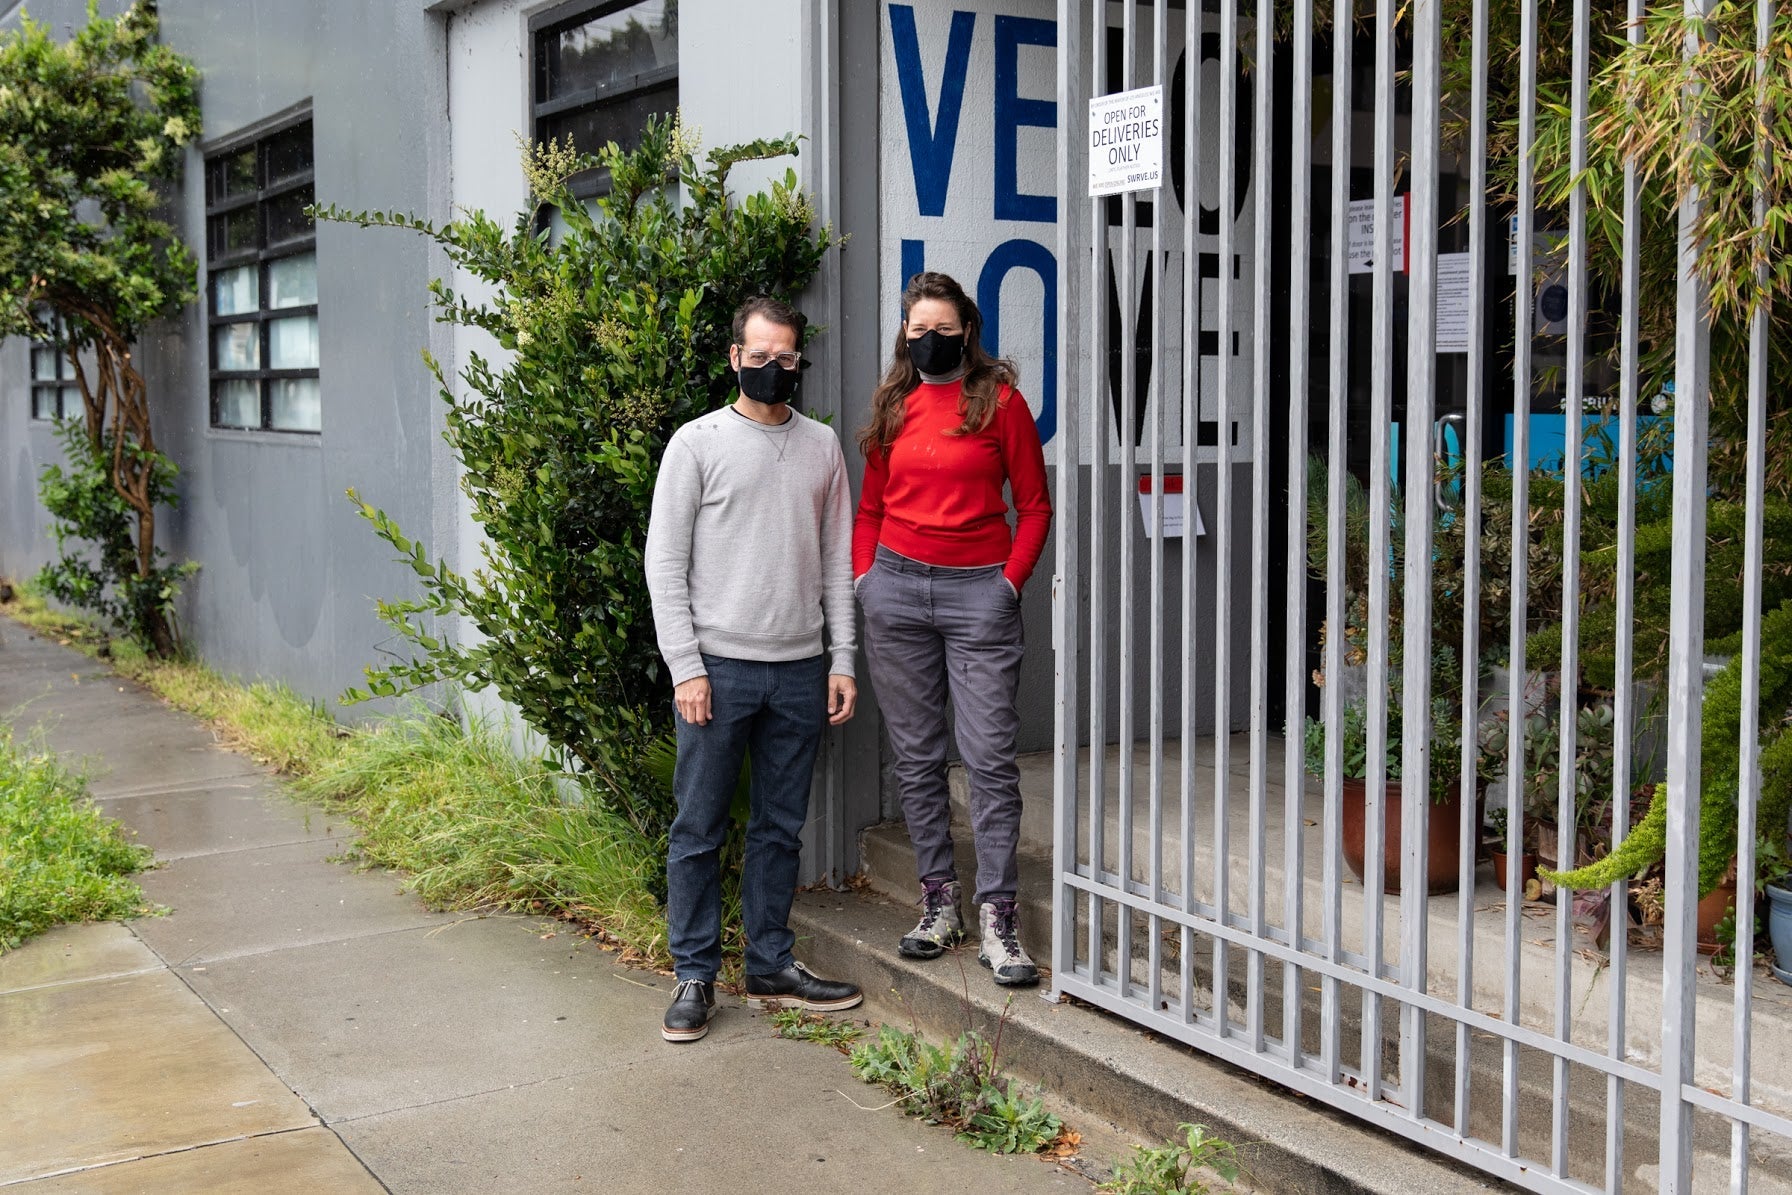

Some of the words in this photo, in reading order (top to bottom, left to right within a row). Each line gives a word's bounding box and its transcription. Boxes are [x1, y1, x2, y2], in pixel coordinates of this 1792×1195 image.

[1104, 108, 1127, 124] OPEN
[1128, 105, 1146, 120] FOR
[1093, 119, 1159, 147] DELIVERIES
[1108, 143, 1141, 165] ONLY
[1127, 171, 1159, 184] SWRVE.US
[1359, 212, 1371, 222] the
